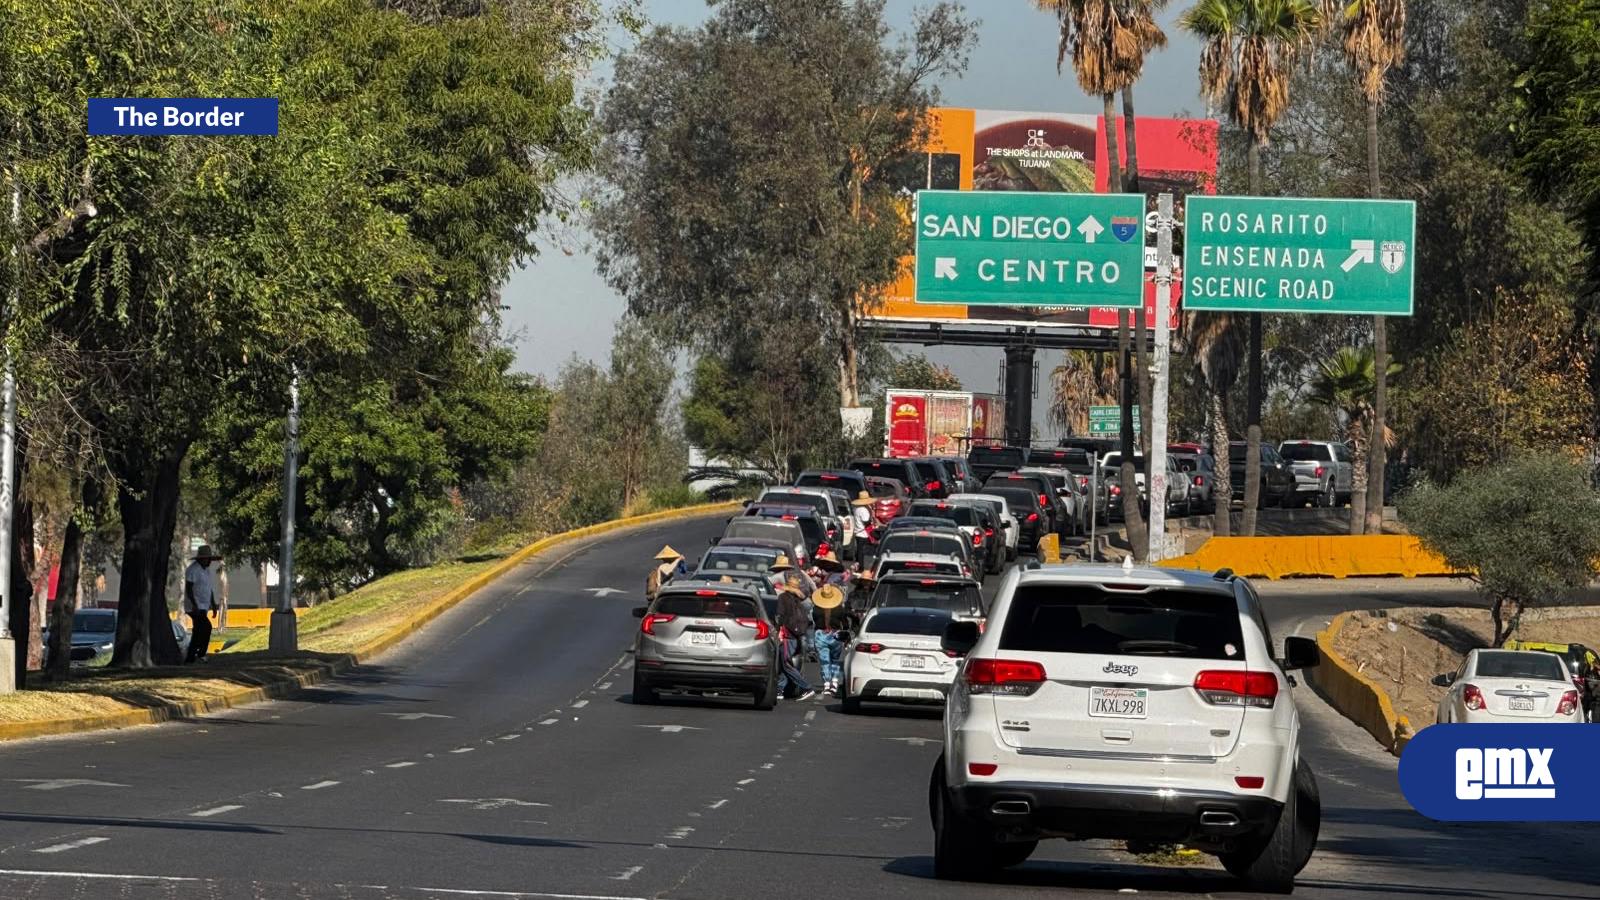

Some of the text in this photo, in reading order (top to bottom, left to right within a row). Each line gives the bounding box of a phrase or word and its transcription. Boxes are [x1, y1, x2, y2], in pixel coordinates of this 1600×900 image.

[986, 147, 1085, 160] THE SHOPS at LANDMARK
[1018, 159, 1051, 168] TIJUANA
[922, 214, 1071, 240] SAN DIEGO
[1120, 226, 1128, 236] 5
[1202, 212, 1327, 235] ROSARITO
[1201, 246, 1325, 269] ENSENADA
[1390, 252, 1395, 263] 1
[978, 259, 1121, 284] CENTRO
[1191, 276, 1335, 300] SCENIC ROAD
[1102, 661, 1138, 677] Jeep
[1094, 698, 1144, 714] 7KXL998
